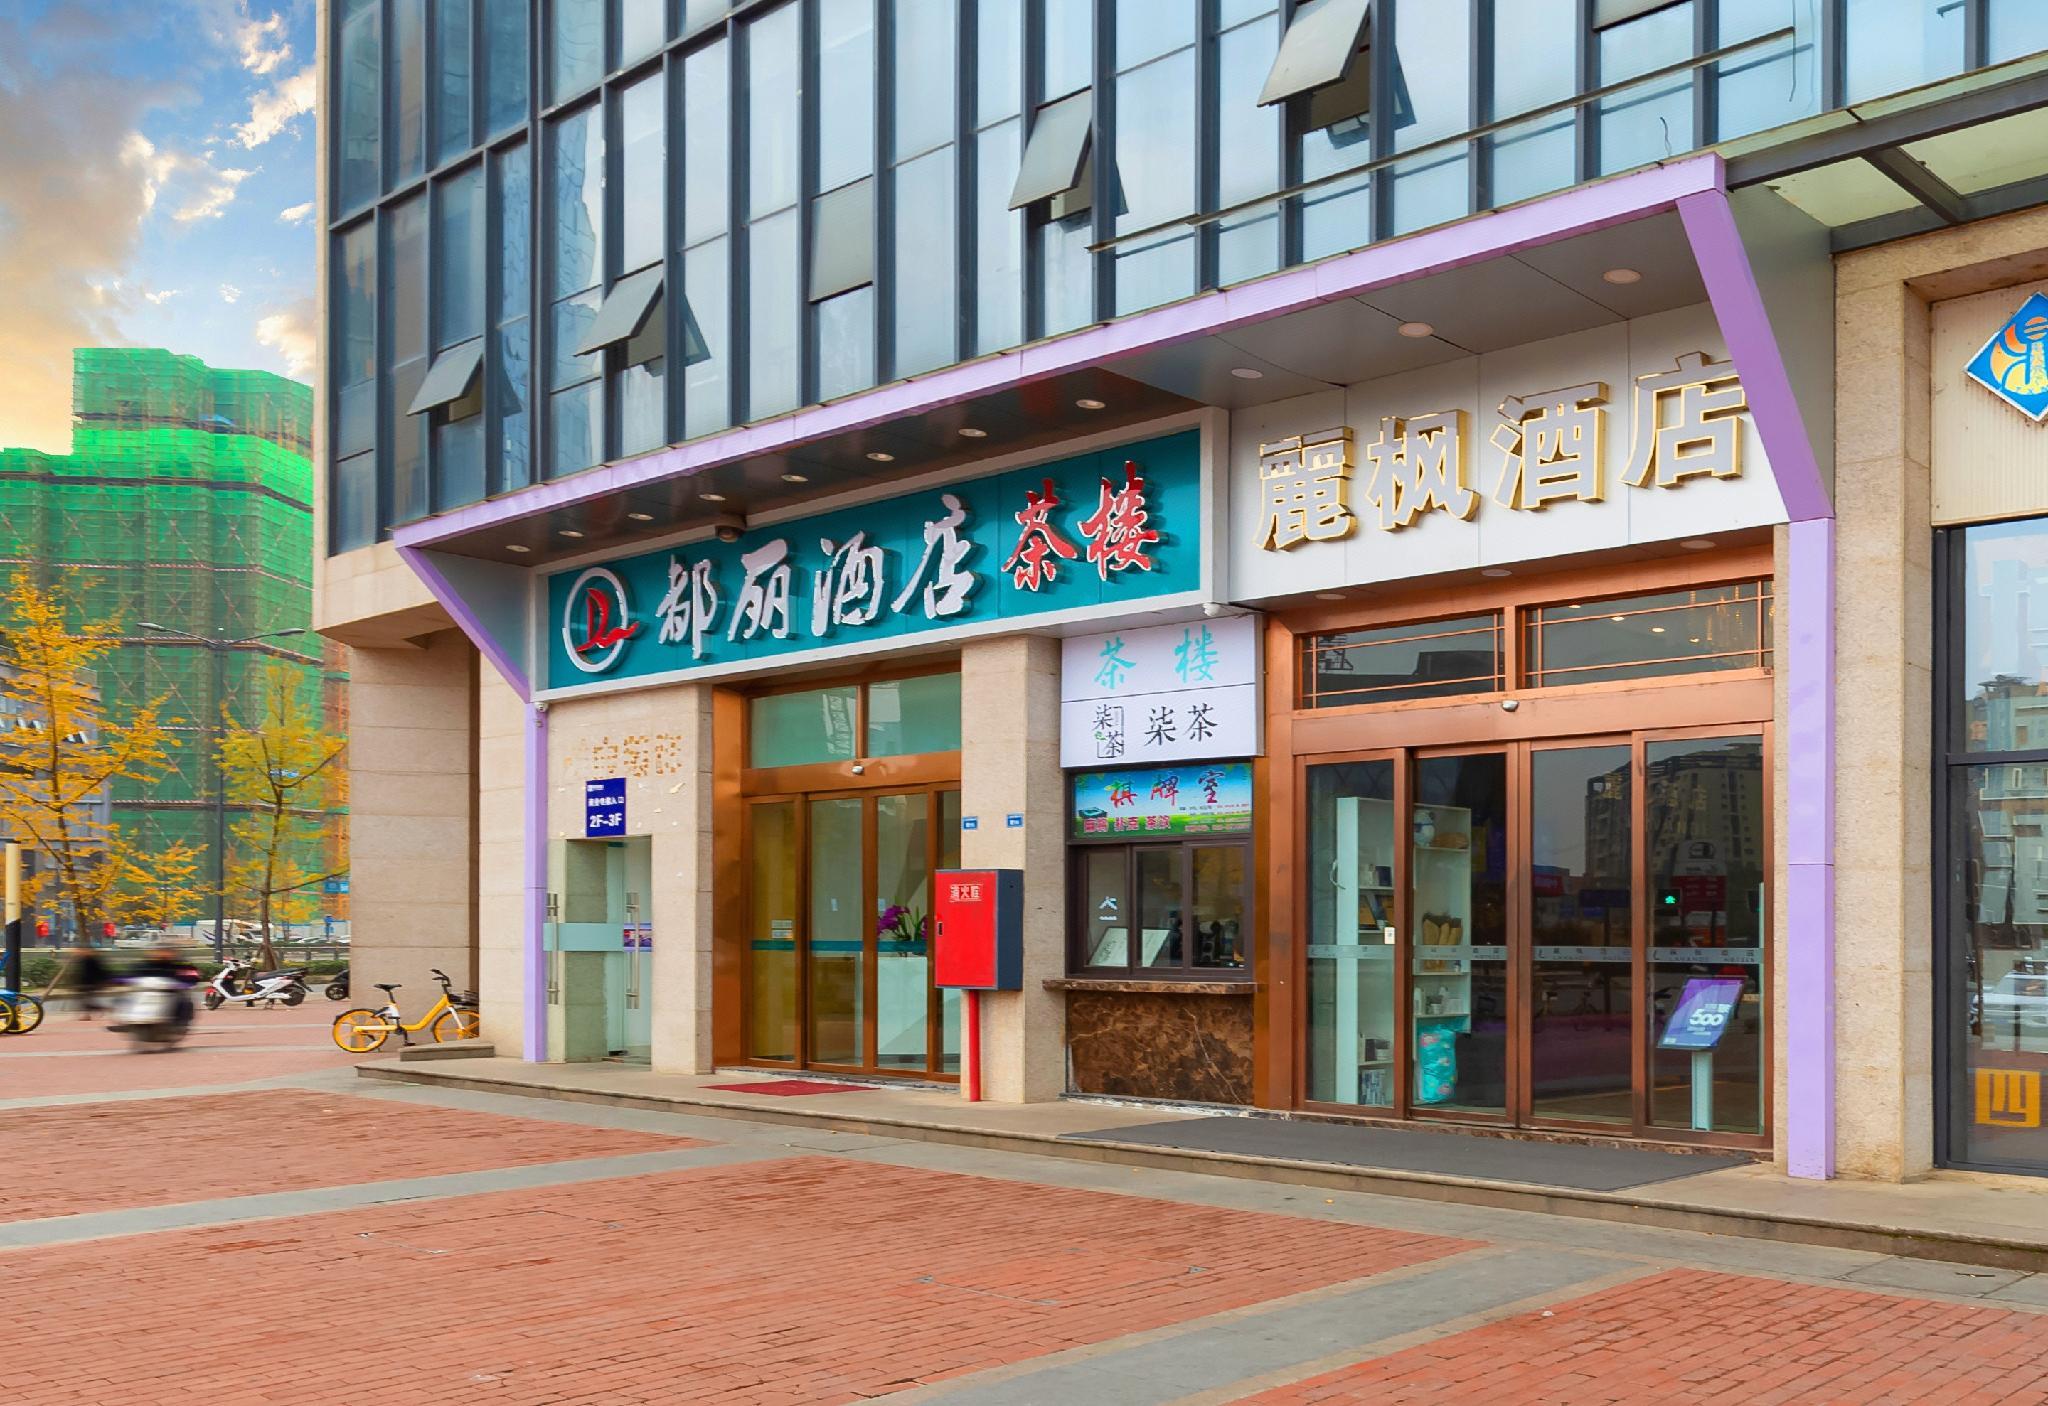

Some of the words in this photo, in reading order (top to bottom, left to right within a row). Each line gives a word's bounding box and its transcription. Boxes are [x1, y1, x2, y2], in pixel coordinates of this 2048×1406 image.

[1252, 351, 1746, 551] 麗枫酒店
[657, 493, 978, 659] 都丽酒店
[1002, 459, 1161, 592] 茶楼
[1093, 624, 1219, 690] 茶楼
[1143, 702, 1219, 747] 柒茶
[1104, 770, 1225, 808] 棋牌室
[589, 813, 623, 828] 2F-3F
[1689, 1008, 1724, 1026] 500
